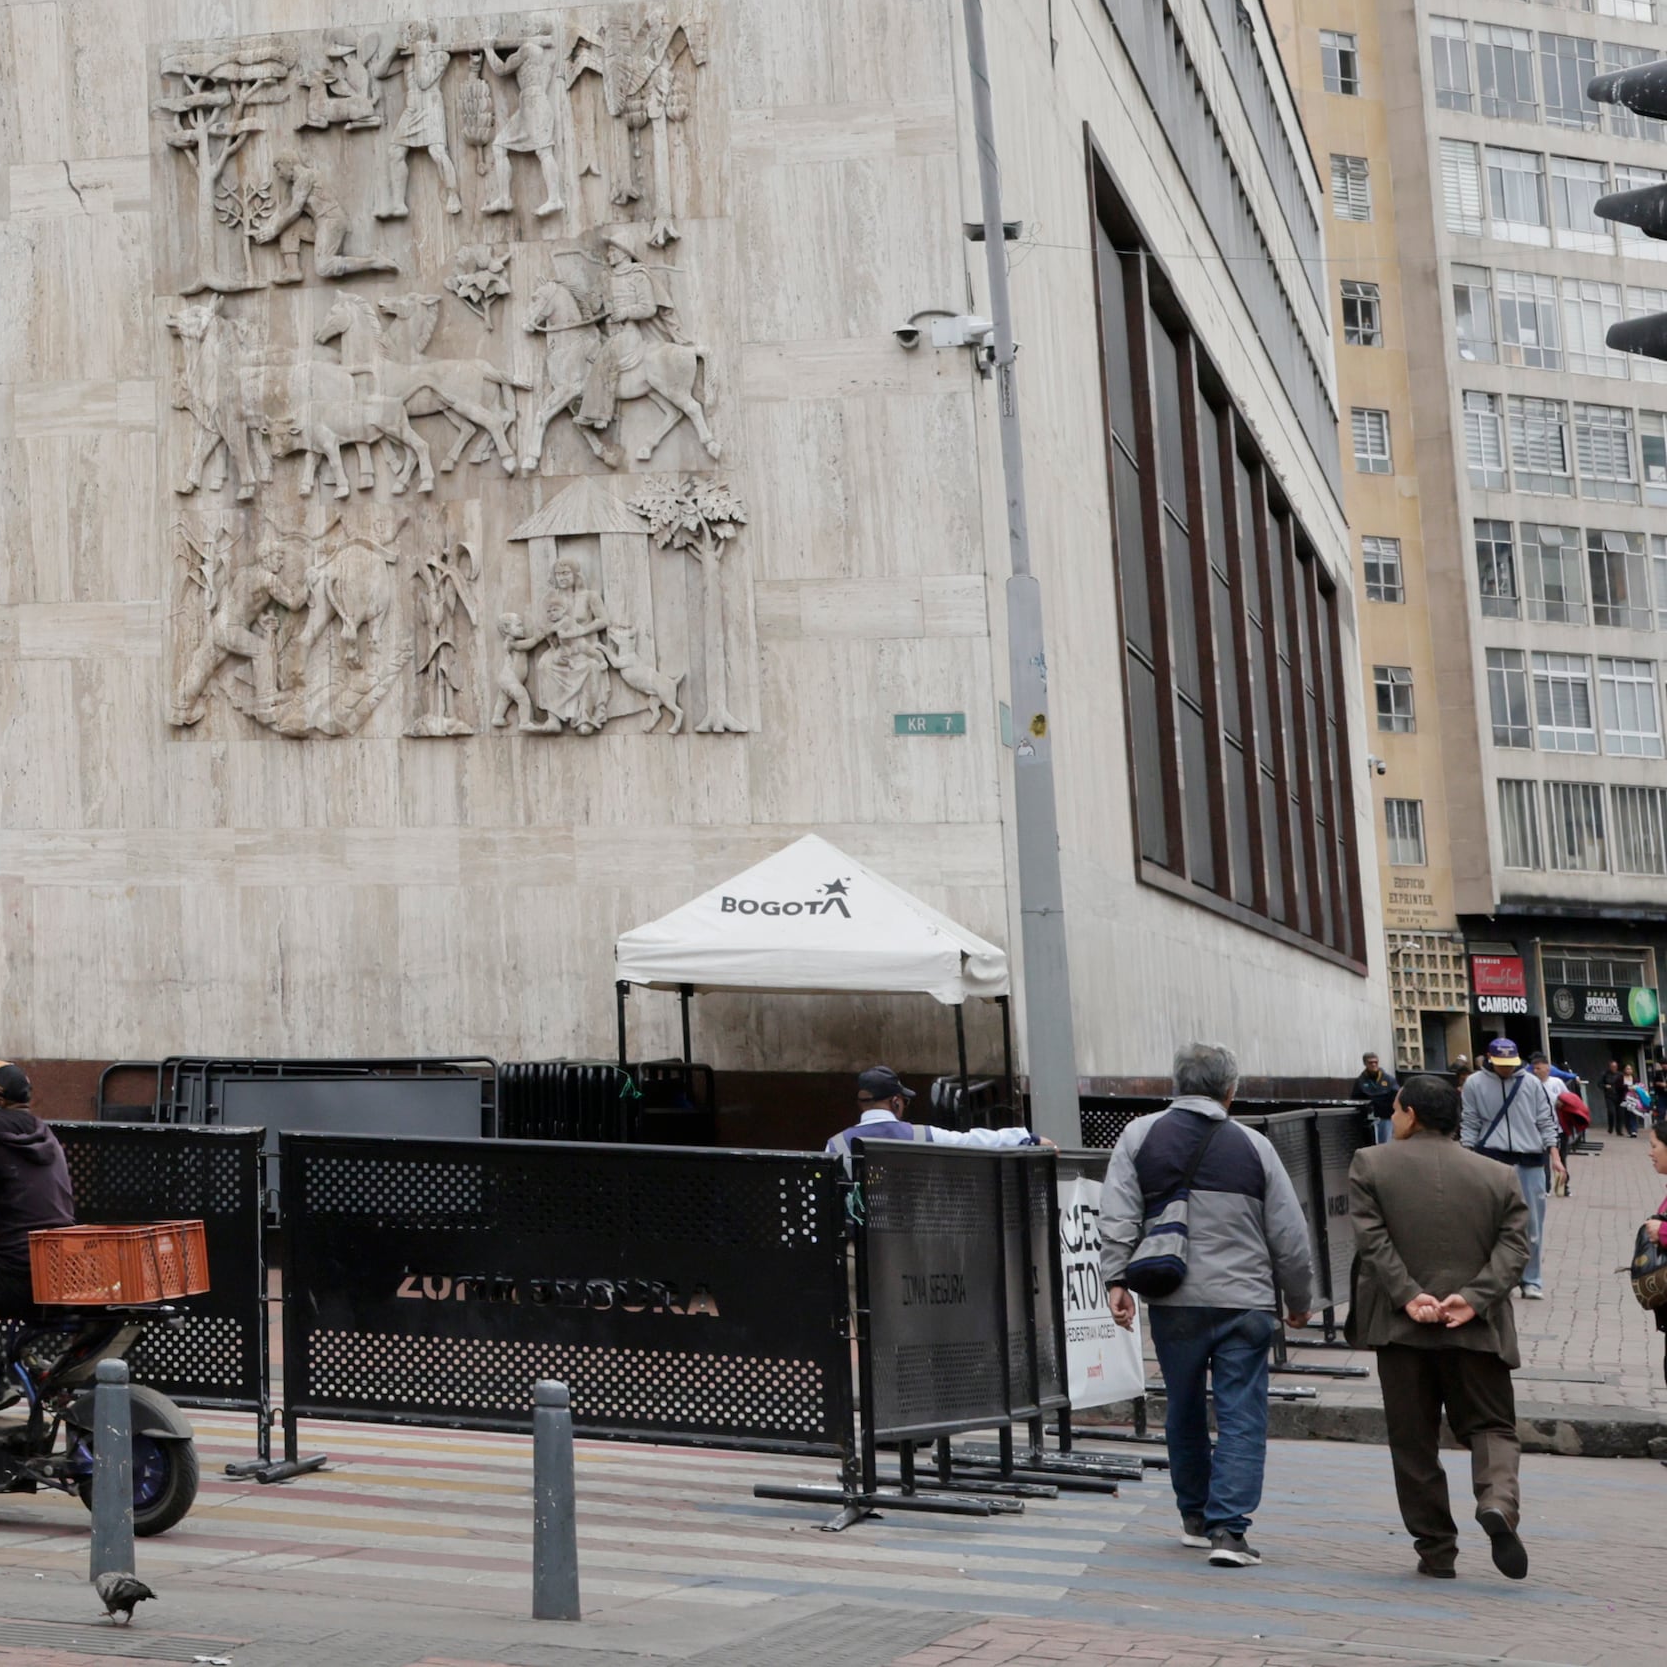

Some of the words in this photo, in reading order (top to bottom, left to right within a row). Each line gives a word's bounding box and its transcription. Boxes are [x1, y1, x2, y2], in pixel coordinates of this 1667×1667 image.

[907, 716, 927, 732] KR
[943, 715, 954, 731] 7
[1478, 995, 1528, 1014] CAMBIOS
[1585, 1005, 1621, 1015] CAMBIOS
[1586, 997, 1618, 1007] BERLIN
[902, 1274, 927, 1306] ZONA
[930, 1274, 966, 1306] SEGURA
